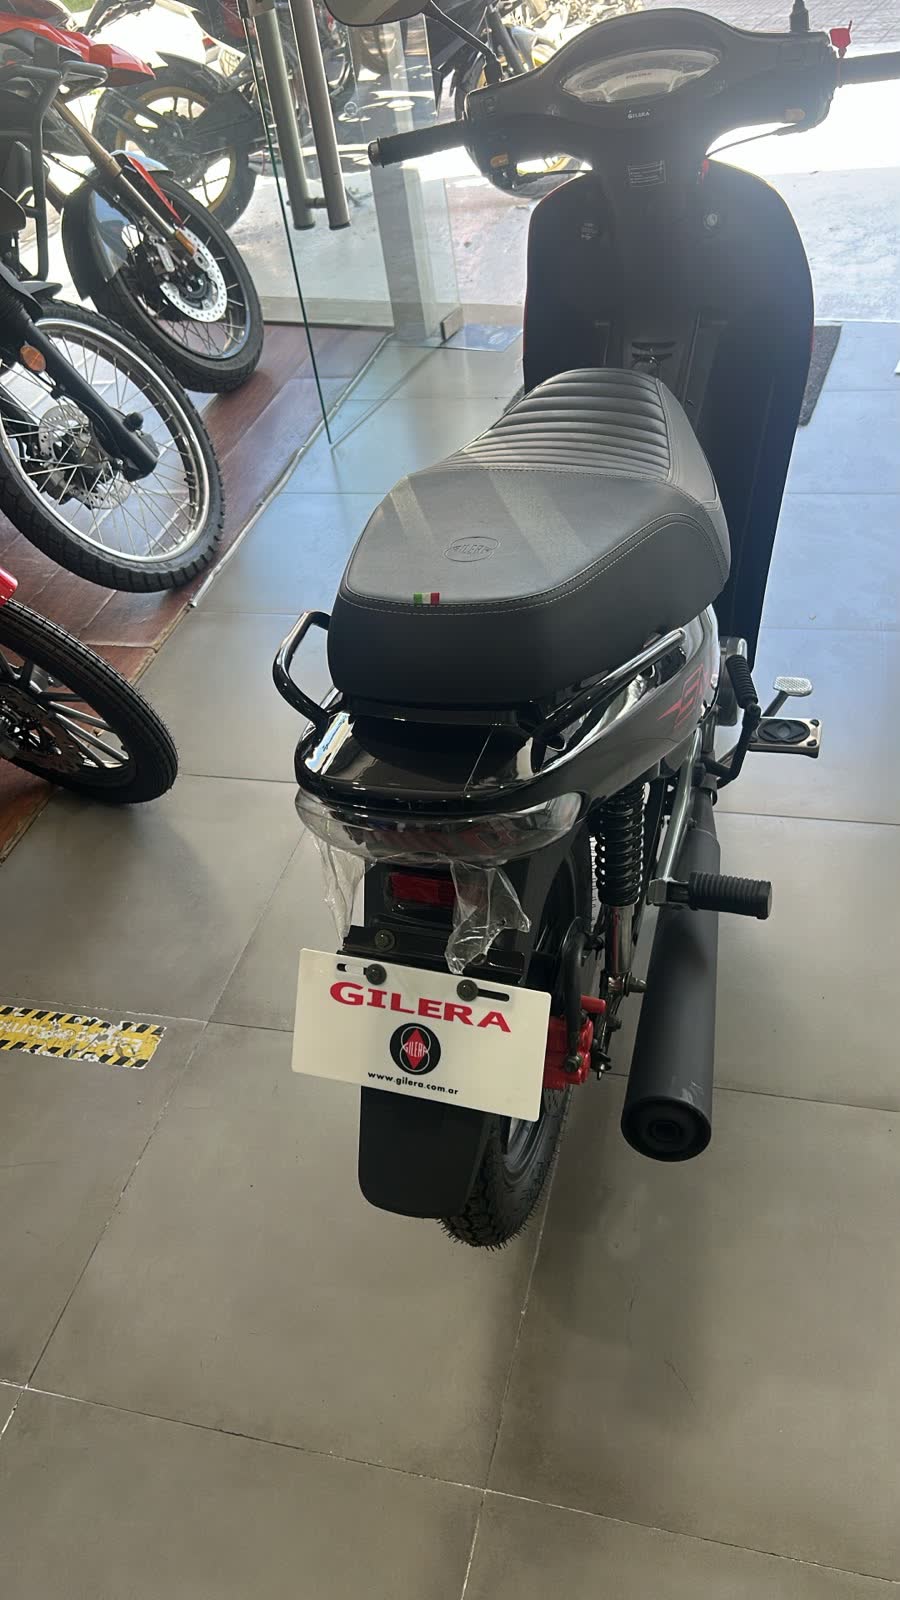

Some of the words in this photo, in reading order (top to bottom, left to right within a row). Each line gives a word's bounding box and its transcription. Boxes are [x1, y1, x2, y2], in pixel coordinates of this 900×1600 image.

[329, 981, 512, 1033] GILERA
[402, 1041, 429, 1058] GILERA
[367, 1071, 460, 1095] www.gilera.com.ar
